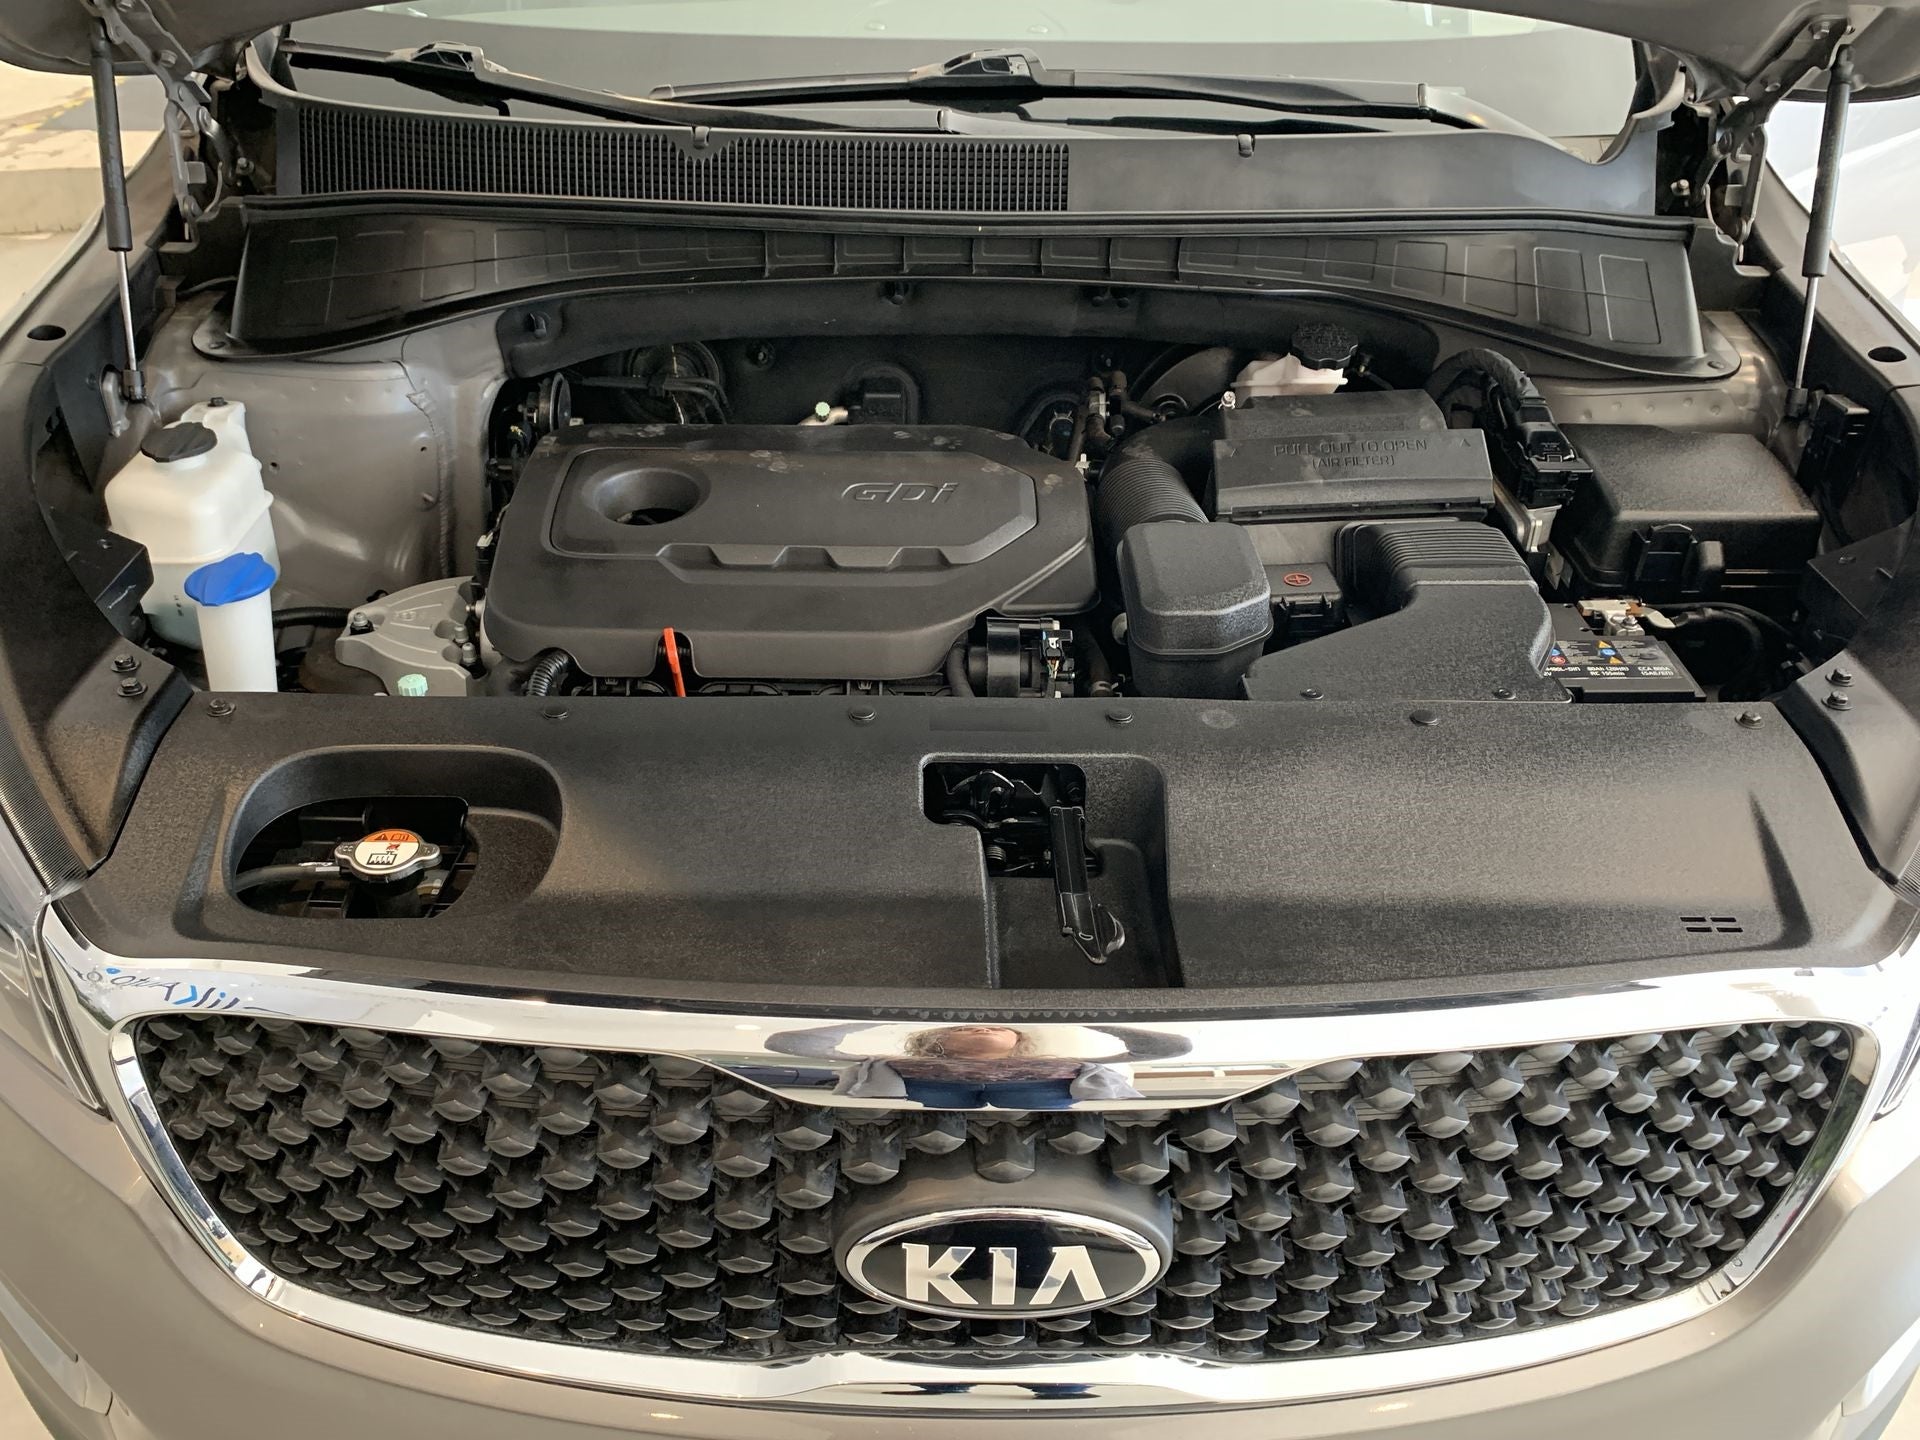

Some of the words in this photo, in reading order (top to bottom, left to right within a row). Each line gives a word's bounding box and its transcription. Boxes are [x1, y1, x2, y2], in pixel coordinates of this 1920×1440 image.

[1273, 442, 1313, 457] PULL
[1319, 441, 1352, 455] OUT
[1359, 440, 1379, 452] TO
[1382, 438, 1428, 452] OPEN
[1312, 456, 1341, 469] (AIR
[1343, 454, 1396, 468] FILTER)
[841, 482, 959, 503] GDi
[901, 1242, 1107, 1305] KIA
